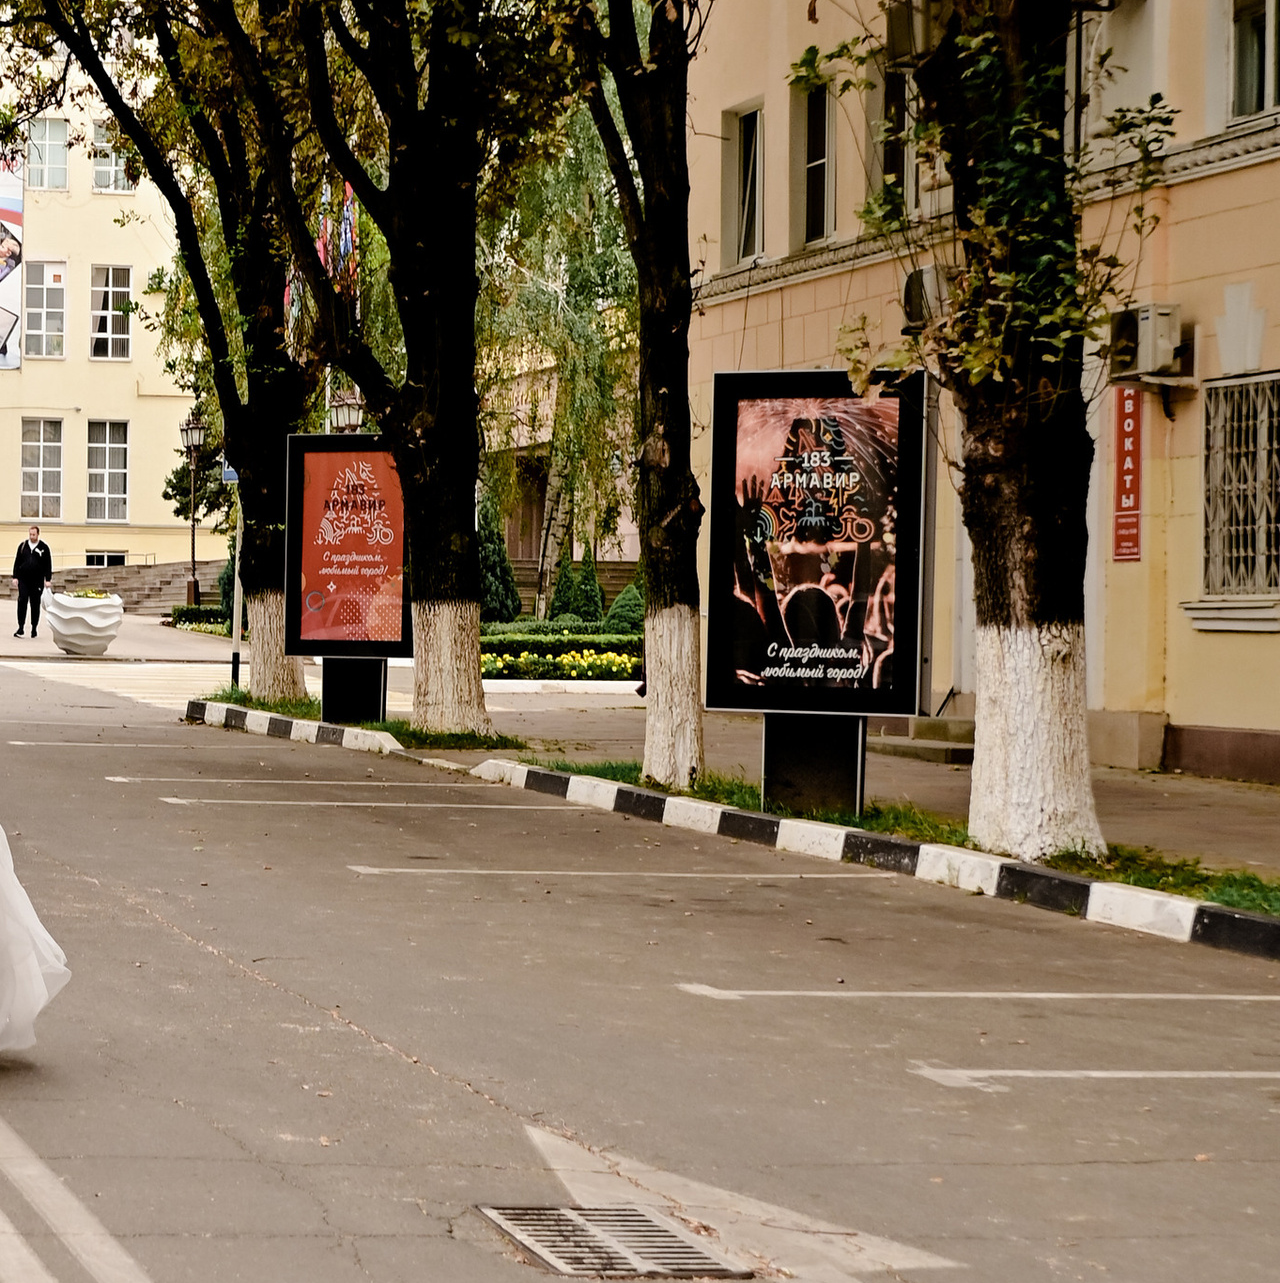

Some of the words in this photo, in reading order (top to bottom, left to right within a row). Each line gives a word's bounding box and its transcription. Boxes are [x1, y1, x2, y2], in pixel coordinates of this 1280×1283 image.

[801, 451, 831, 467] 183
[770, 472, 860, 489] АРМАВИР
[346, 484, 365, 495] 183
[324, 500, 386, 511] АРМАВИР
[323, 551, 330, 561] С
[319, 564, 359, 575] любимый
[360, 565, 388, 578] город!
[767, 642, 778, 658] С
[761, 662, 824, 678] любимый
[826, 664, 869, 683] город!
